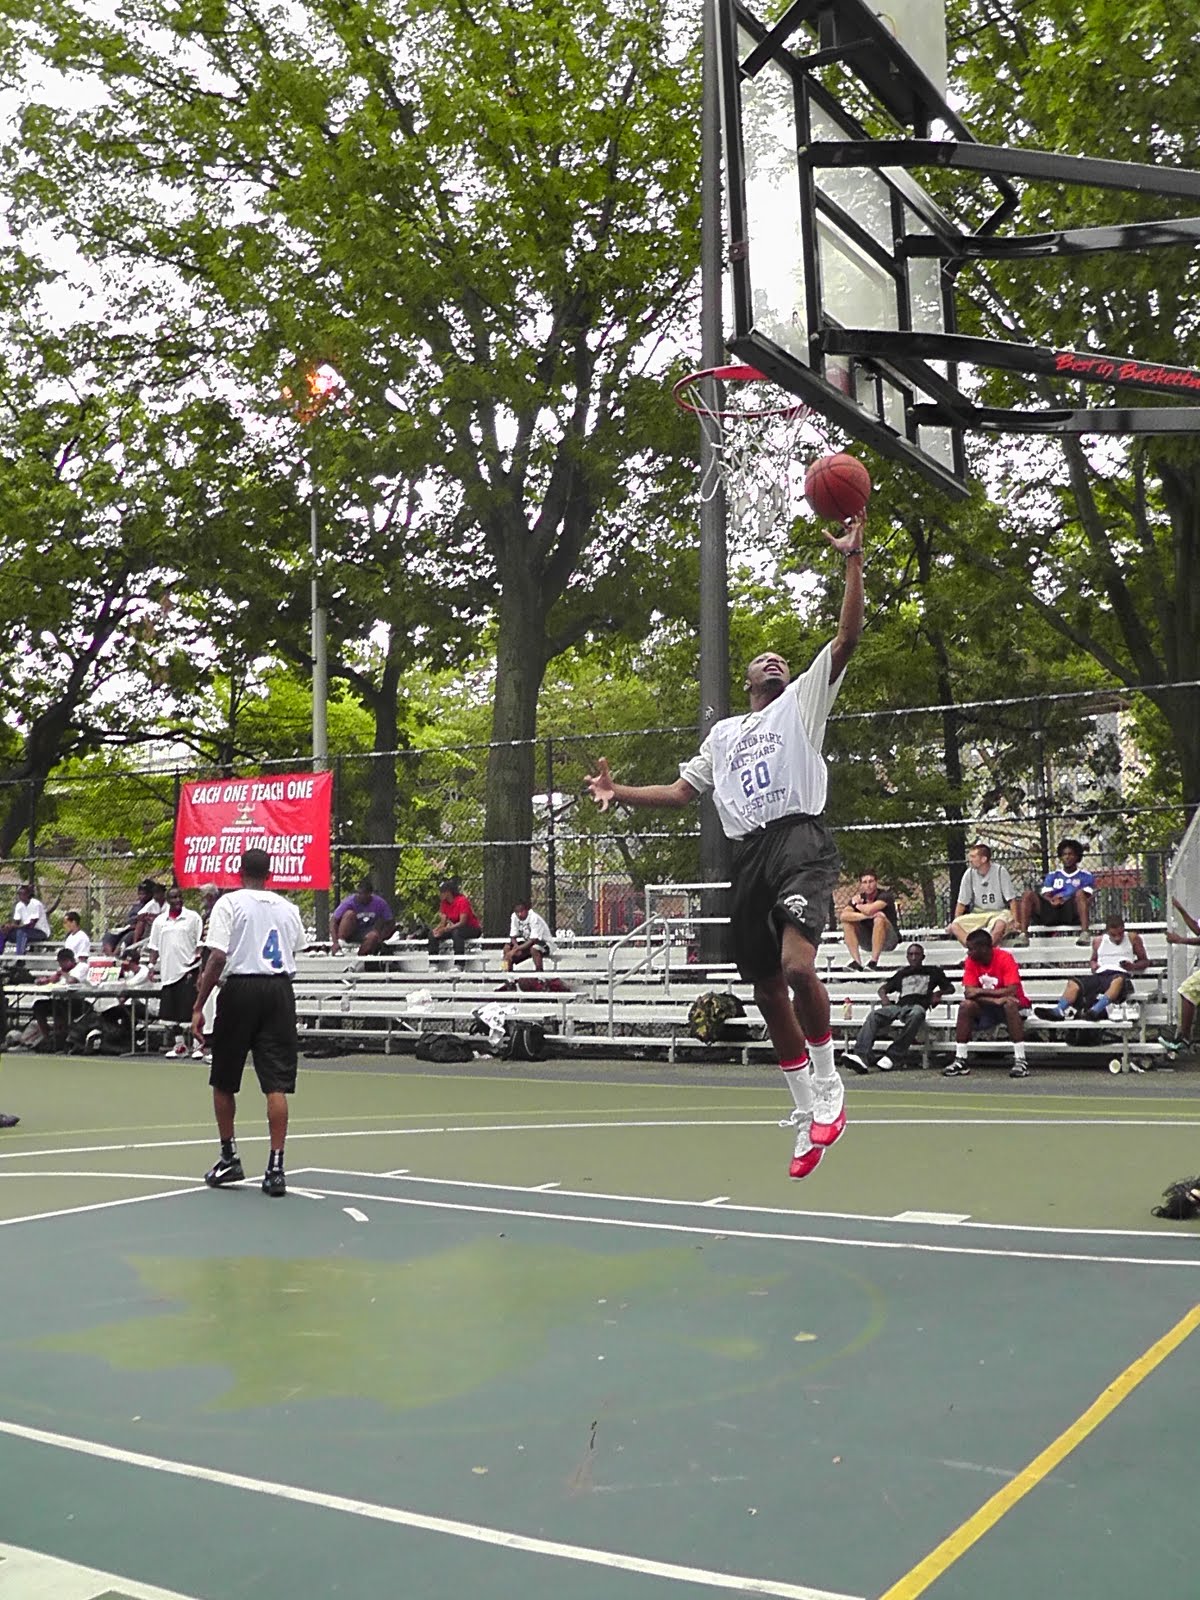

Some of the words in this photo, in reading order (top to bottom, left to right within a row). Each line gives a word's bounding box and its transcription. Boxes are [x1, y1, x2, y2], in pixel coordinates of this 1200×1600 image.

[740, 761, 771, 798] 20
[191, 786, 221, 804] EACH
[223, 784, 248, 802] ONE
[251, 782, 284, 802] TEACH
[287, 780, 314, 799] ONE
[184, 835, 217, 854] "STOP
[219, 835, 242, 853] THE
[184, 855, 198, 873] IN
[200, 855, 223, 873] THE
[981, 893, 996, 905] 28
[262, 928, 283, 969] 4
